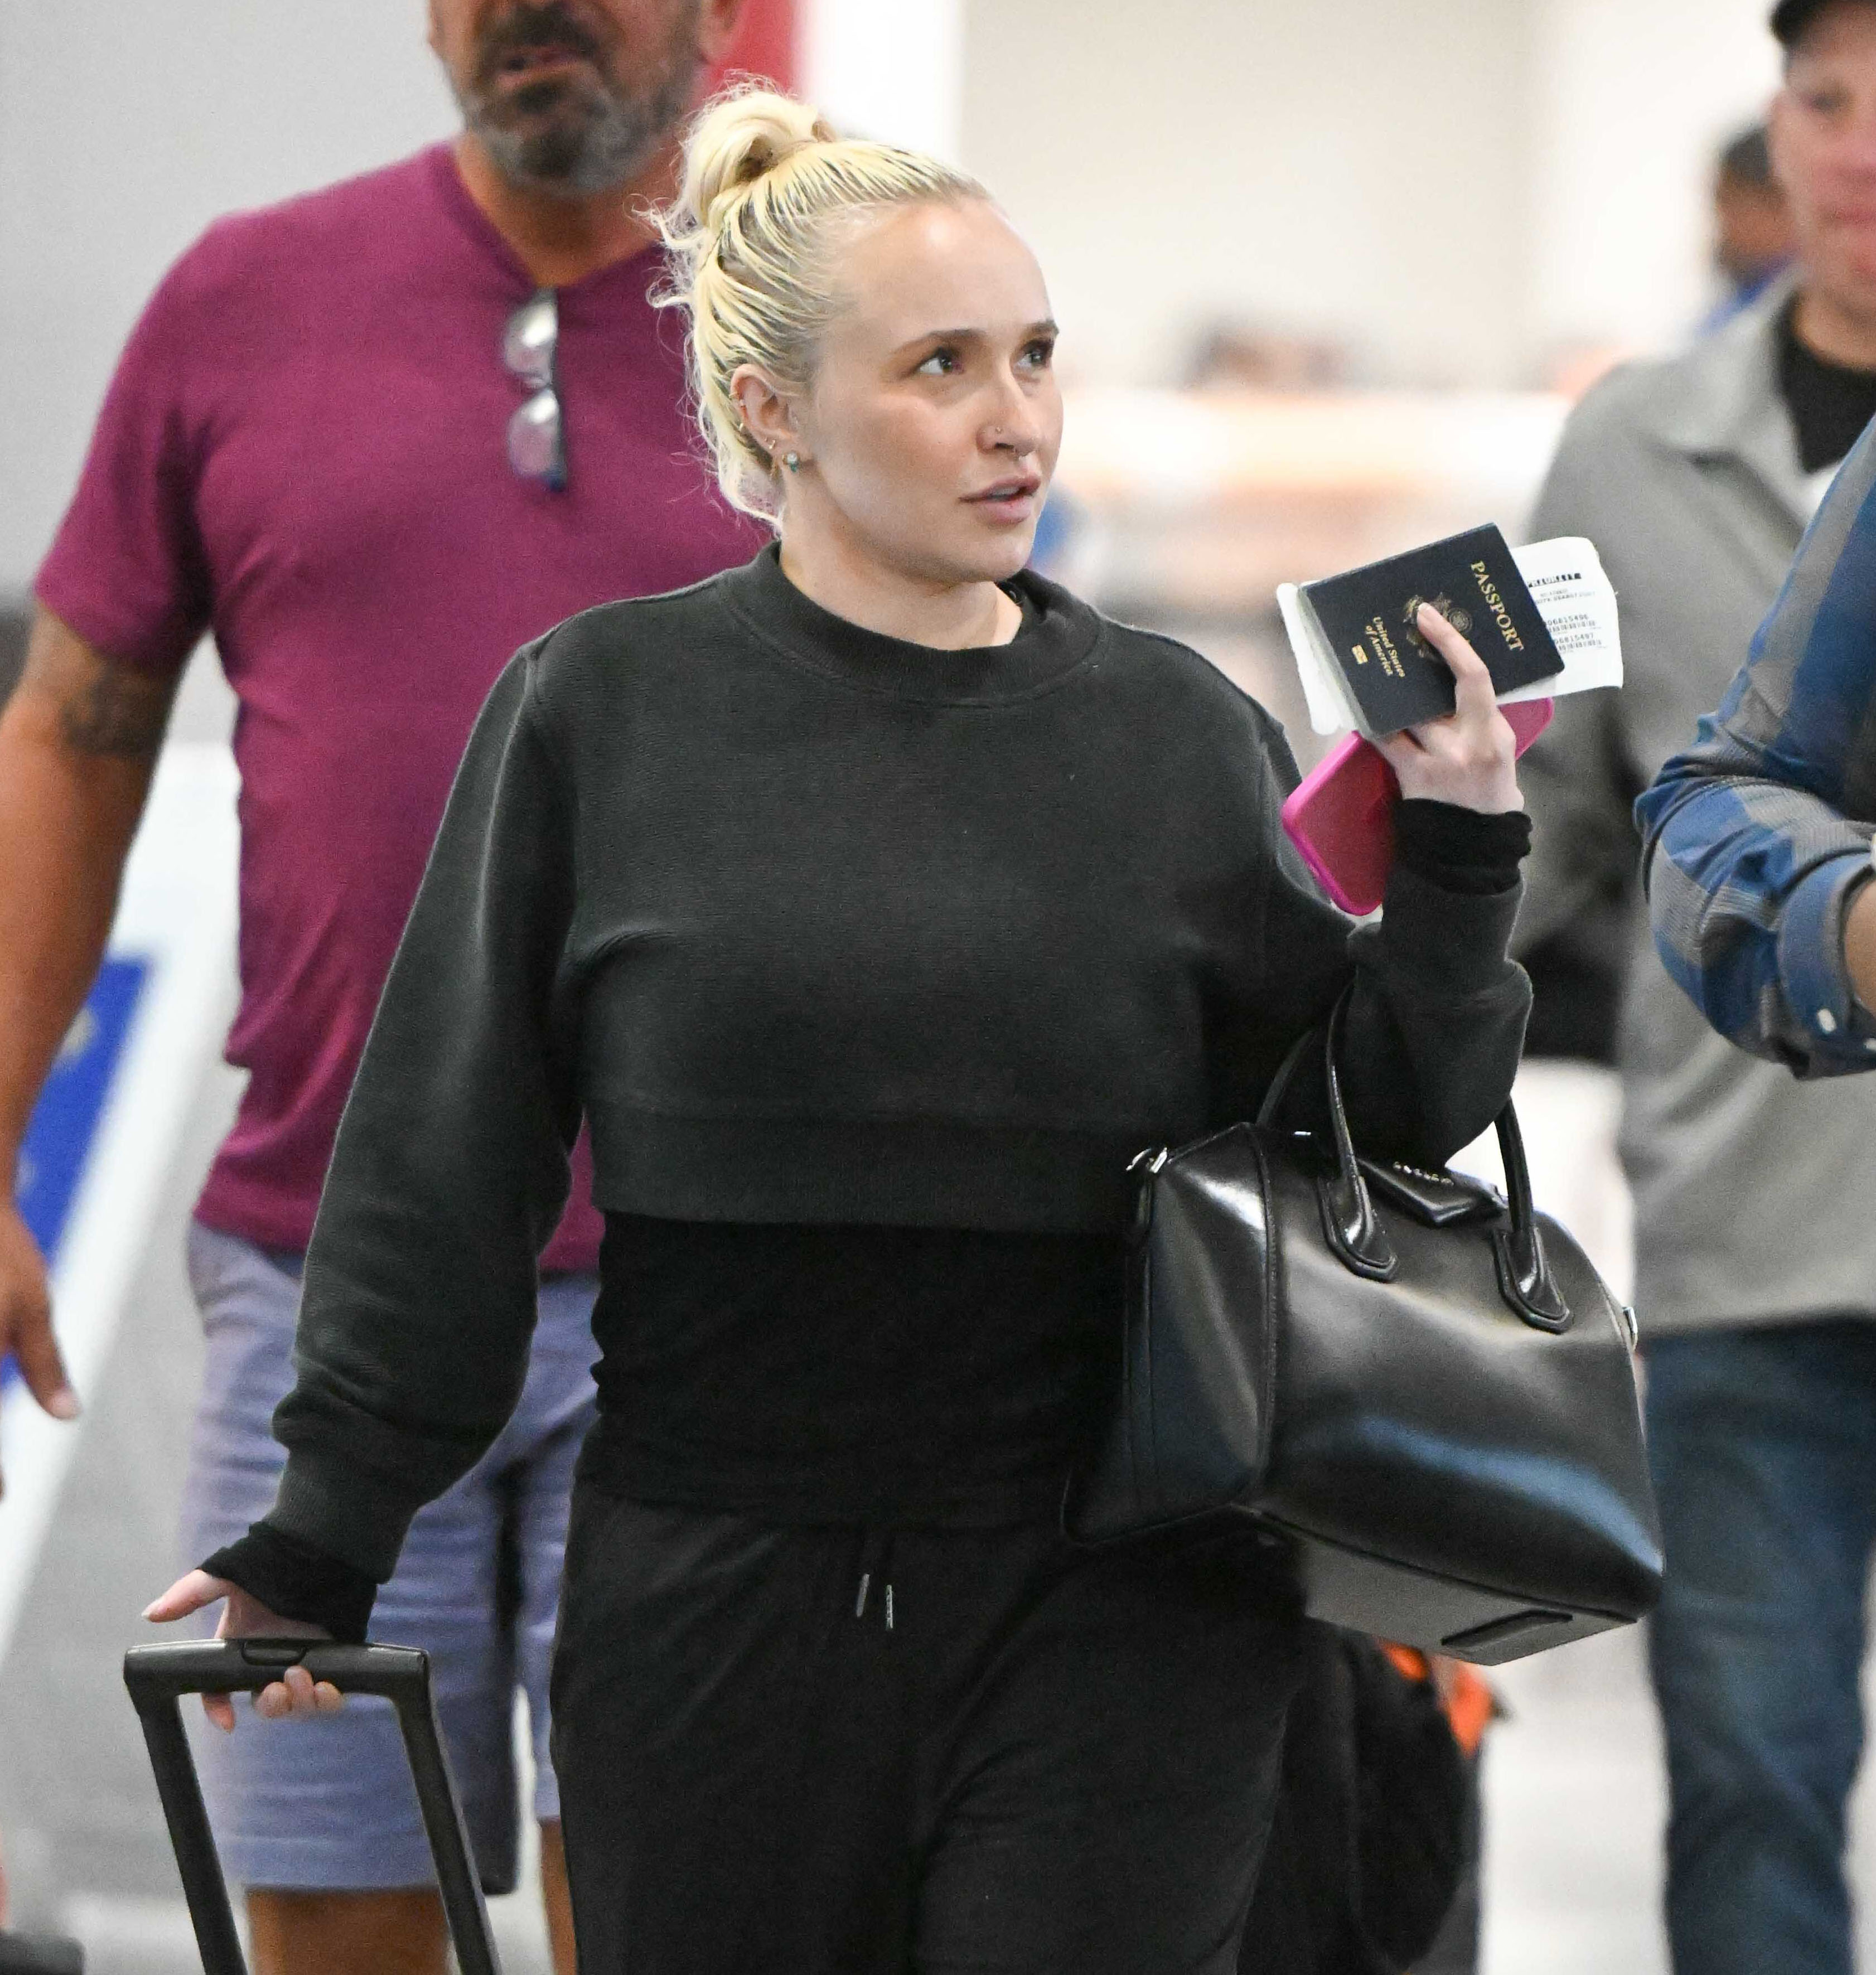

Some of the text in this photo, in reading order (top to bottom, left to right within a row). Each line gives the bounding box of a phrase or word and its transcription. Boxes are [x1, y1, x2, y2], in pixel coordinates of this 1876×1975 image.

[1471, 560, 1524, 651] PASSPORT
[1365, 626, 1393, 676] of America
[1373, 617, 1405, 677] United States
